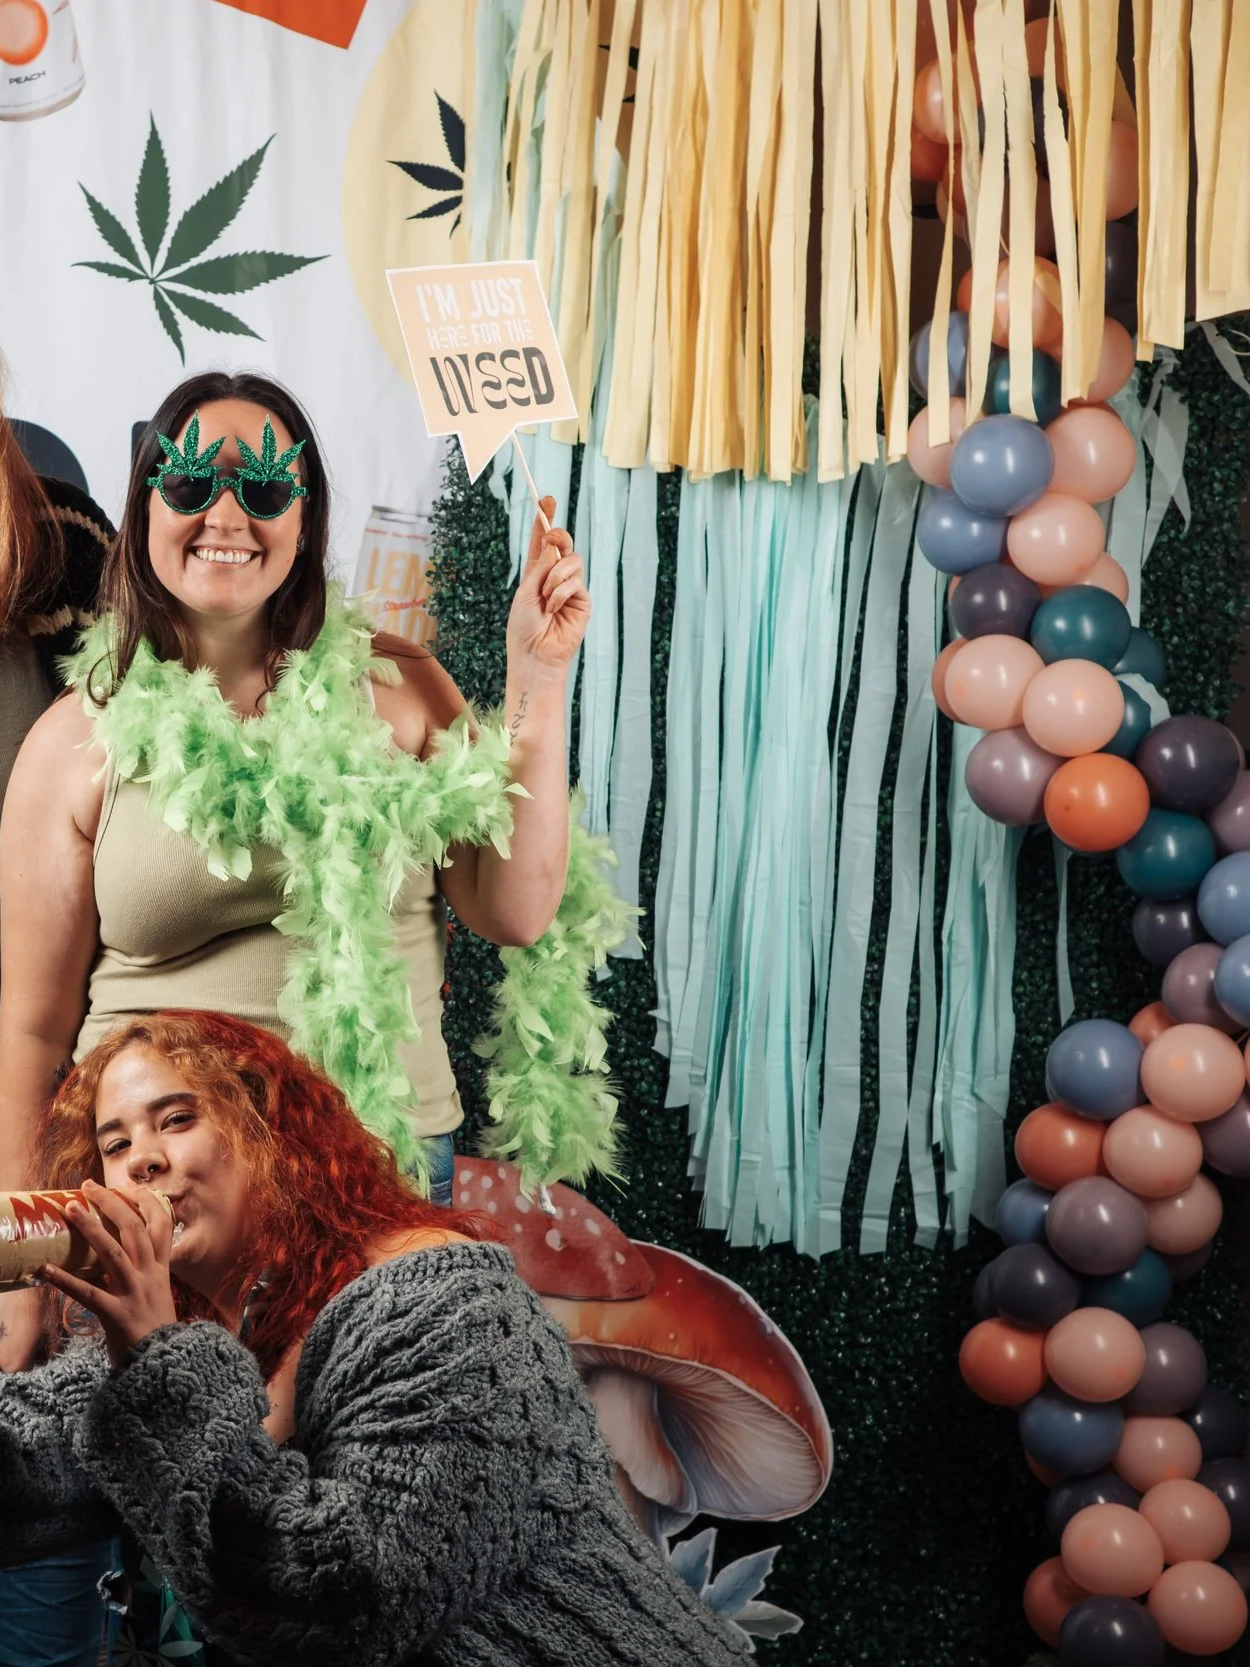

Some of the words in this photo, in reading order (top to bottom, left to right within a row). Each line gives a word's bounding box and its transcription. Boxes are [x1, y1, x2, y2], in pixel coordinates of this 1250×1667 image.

[8, 70, 47, 85] PEACH
[415, 282, 461, 324] I'M
[470, 277, 527, 318] JUST
[426, 325, 469, 350] HERE
[470, 321, 502, 346] FOR
[503, 318, 534, 342] THE
[429, 346, 555, 416] WEED
